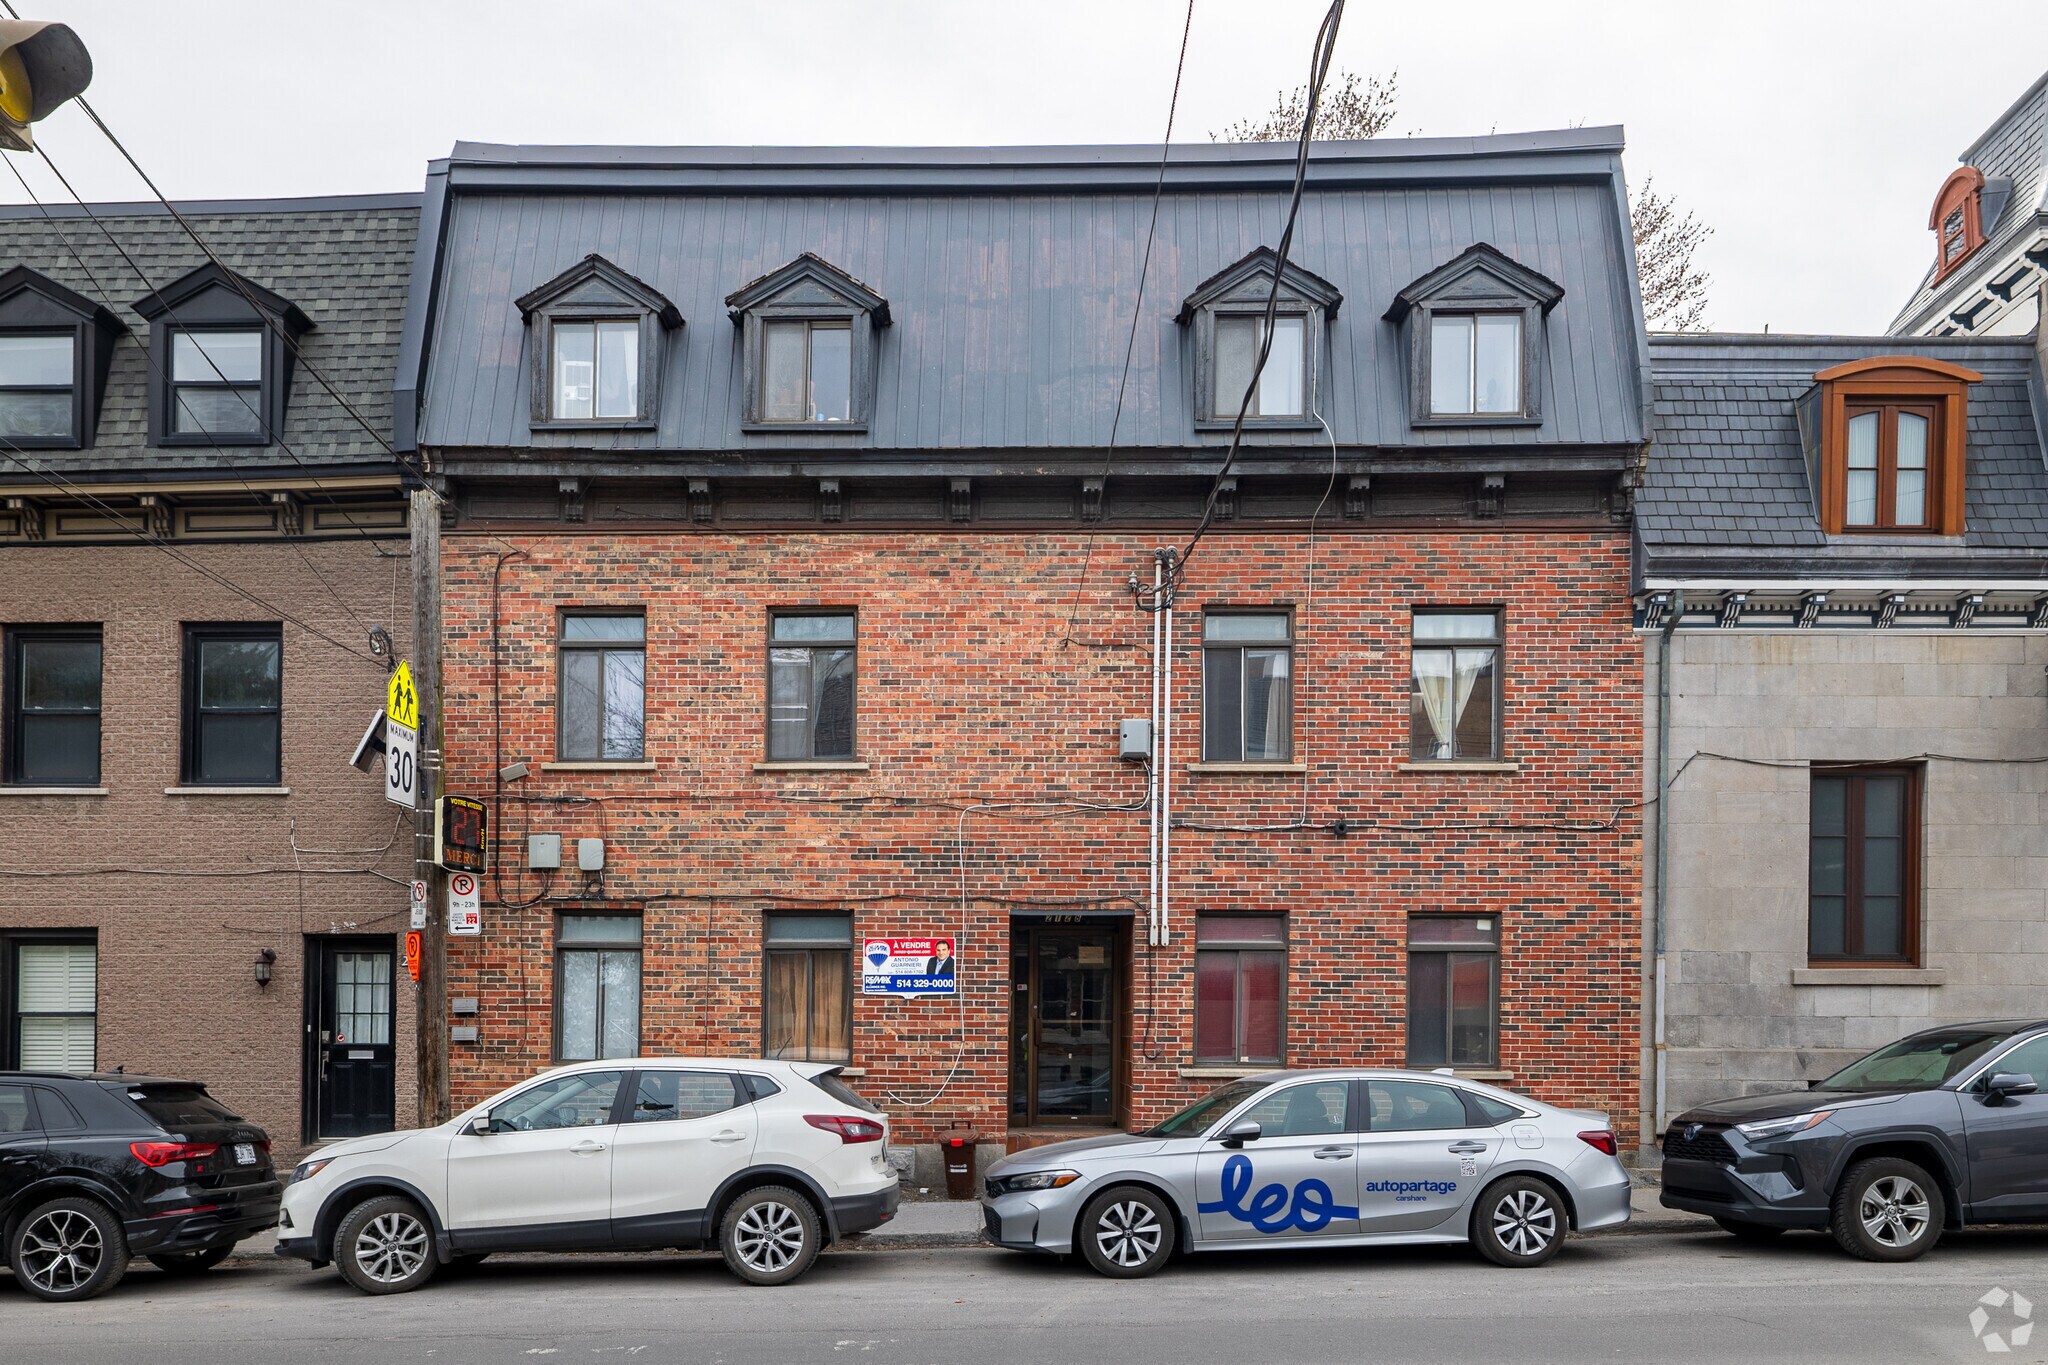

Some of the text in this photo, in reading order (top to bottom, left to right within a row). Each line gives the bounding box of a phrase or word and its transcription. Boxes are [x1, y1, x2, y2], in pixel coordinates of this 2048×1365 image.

[390, 723, 414, 743] MAXIMUM
[390, 746, 412, 793] 30
[450, 797, 467, 807] VOTRE
[445, 848, 481, 867] MERCI
[893, 940, 899, 949] À
[865, 975, 892, 985] RE/MAX
[896, 979, 954, 988] 514 329-0000
[1198, 1154, 1359, 1234] leo
[1366, 1180, 1457, 1195] autopartage
